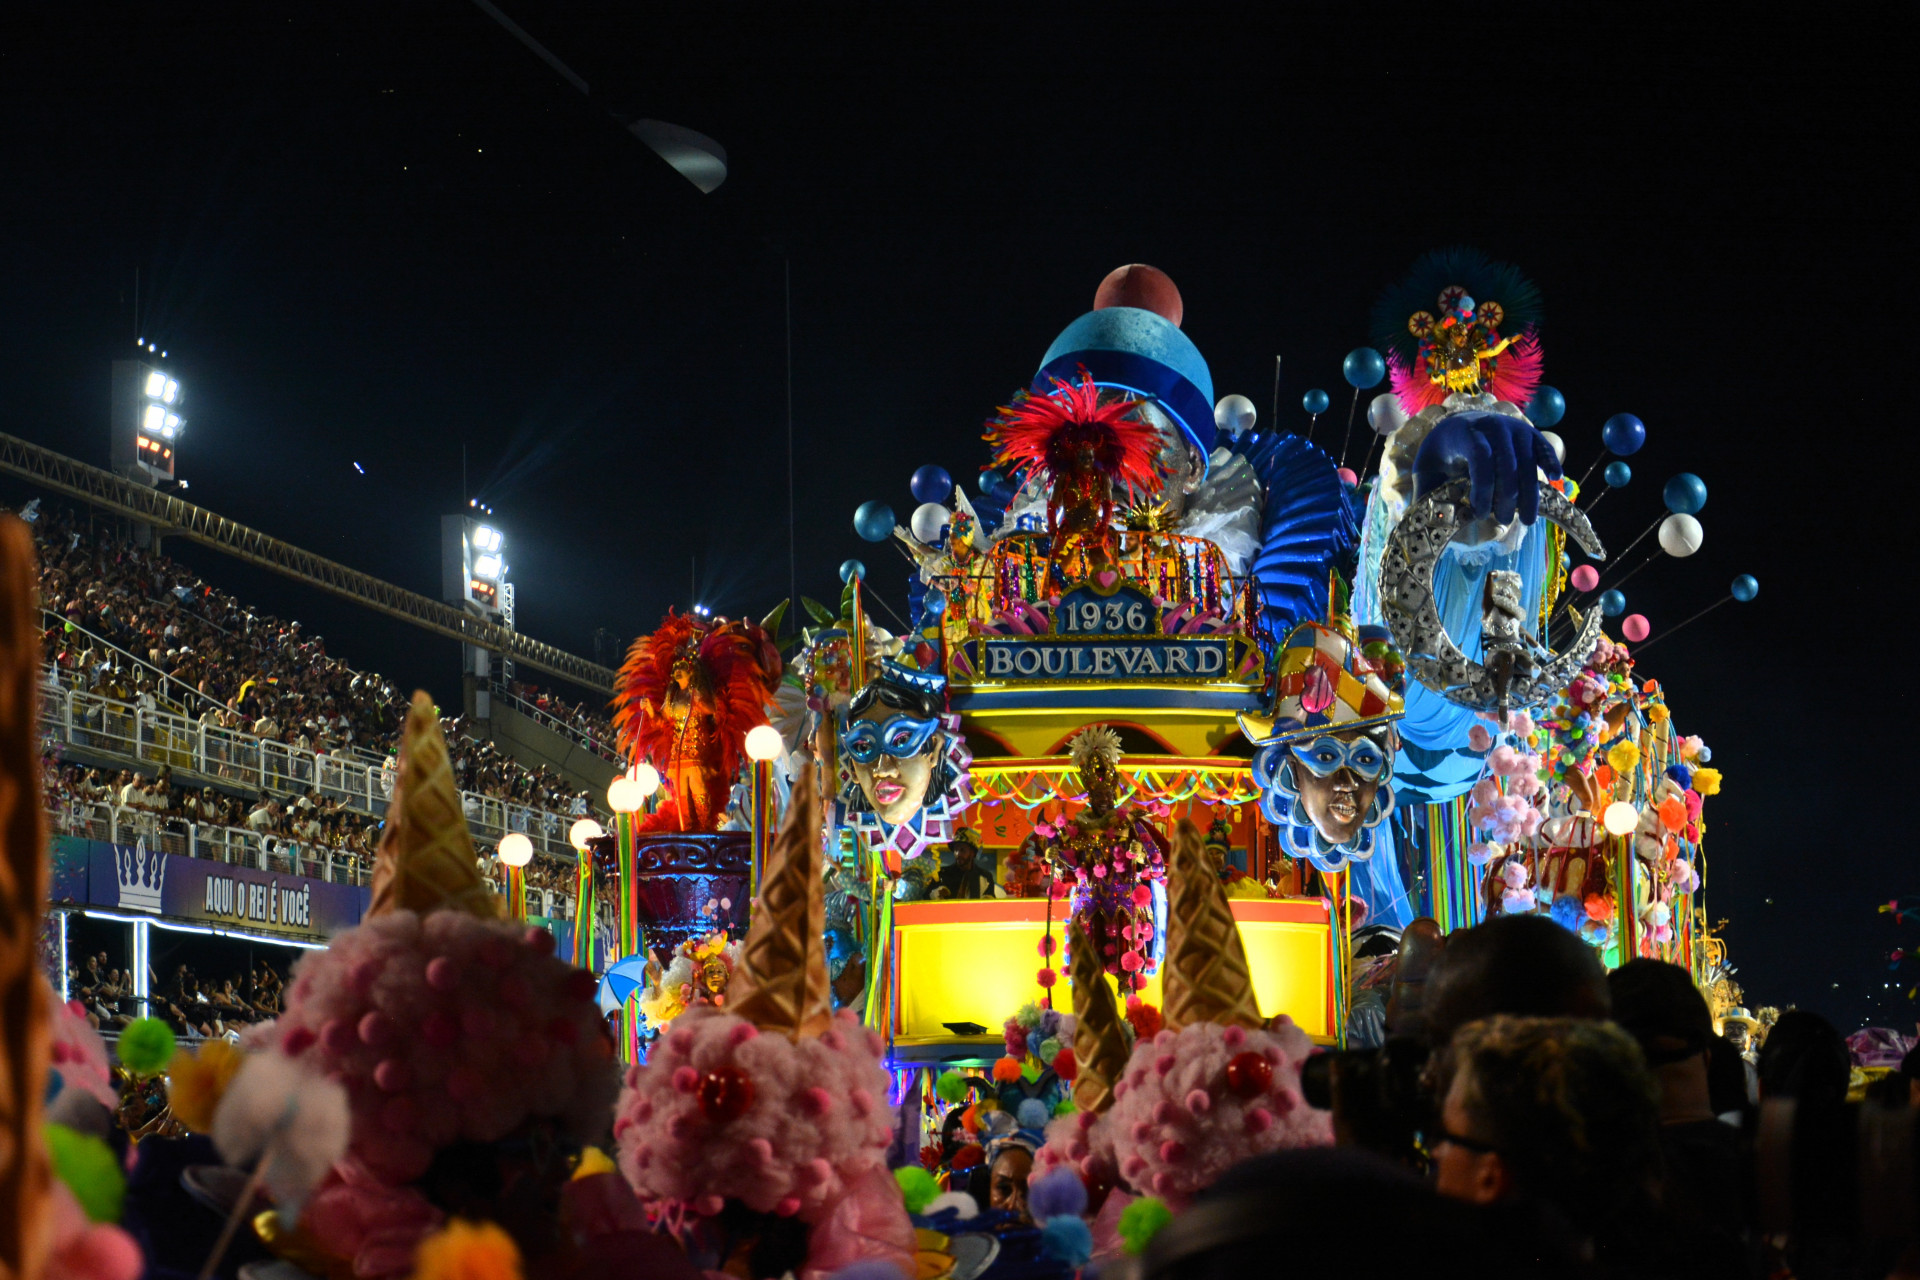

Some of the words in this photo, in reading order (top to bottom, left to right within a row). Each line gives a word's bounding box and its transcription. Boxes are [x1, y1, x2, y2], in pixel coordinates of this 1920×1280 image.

[1066, 602, 1146, 631] 1936
[988, 646, 1224, 675] BOULEVARD
[205, 876, 233, 915] AQUI
[237, 882, 245, 918] O
[249, 884, 267, 920] REI
[270, 879, 277, 922] É
[281, 883, 310, 926] VOCÊ
